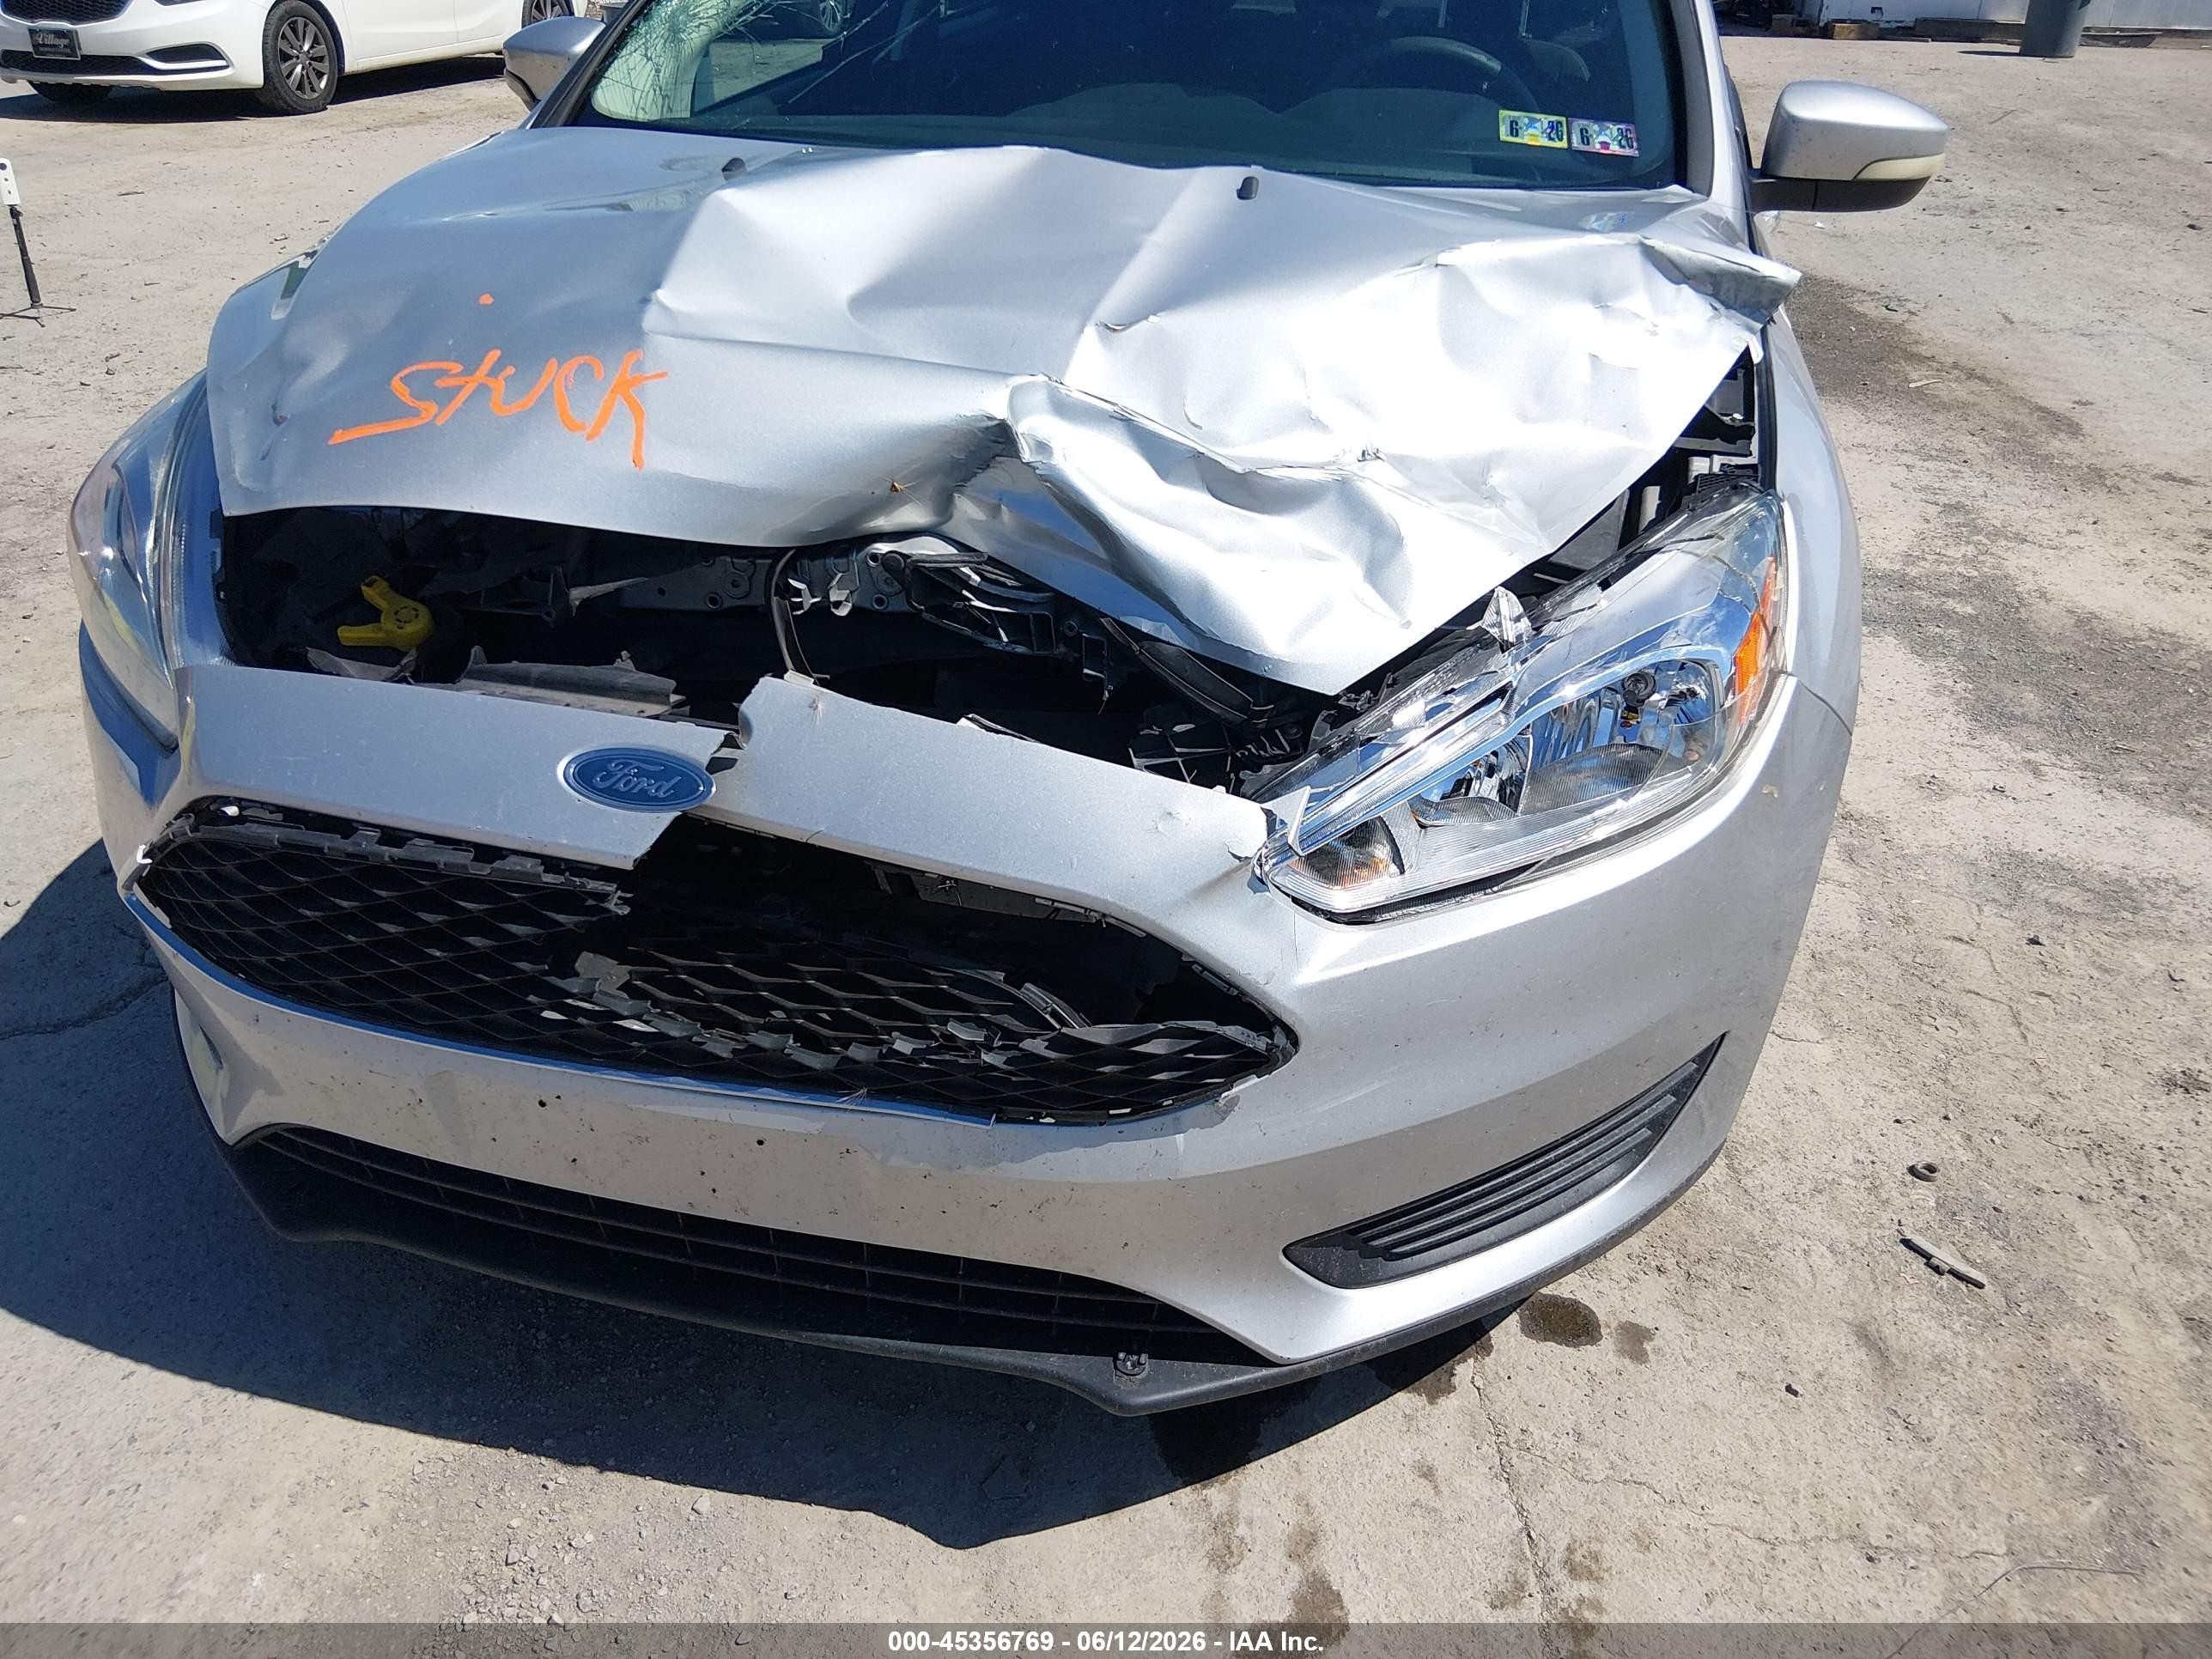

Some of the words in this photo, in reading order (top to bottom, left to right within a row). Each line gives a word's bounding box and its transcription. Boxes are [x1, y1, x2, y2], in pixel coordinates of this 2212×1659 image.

[33, 33, 70, 49] Village
[1547, 120, 1564, 142] 26
[1617, 127, 1634, 149] 26
[592, 757, 683, 799] Ford
